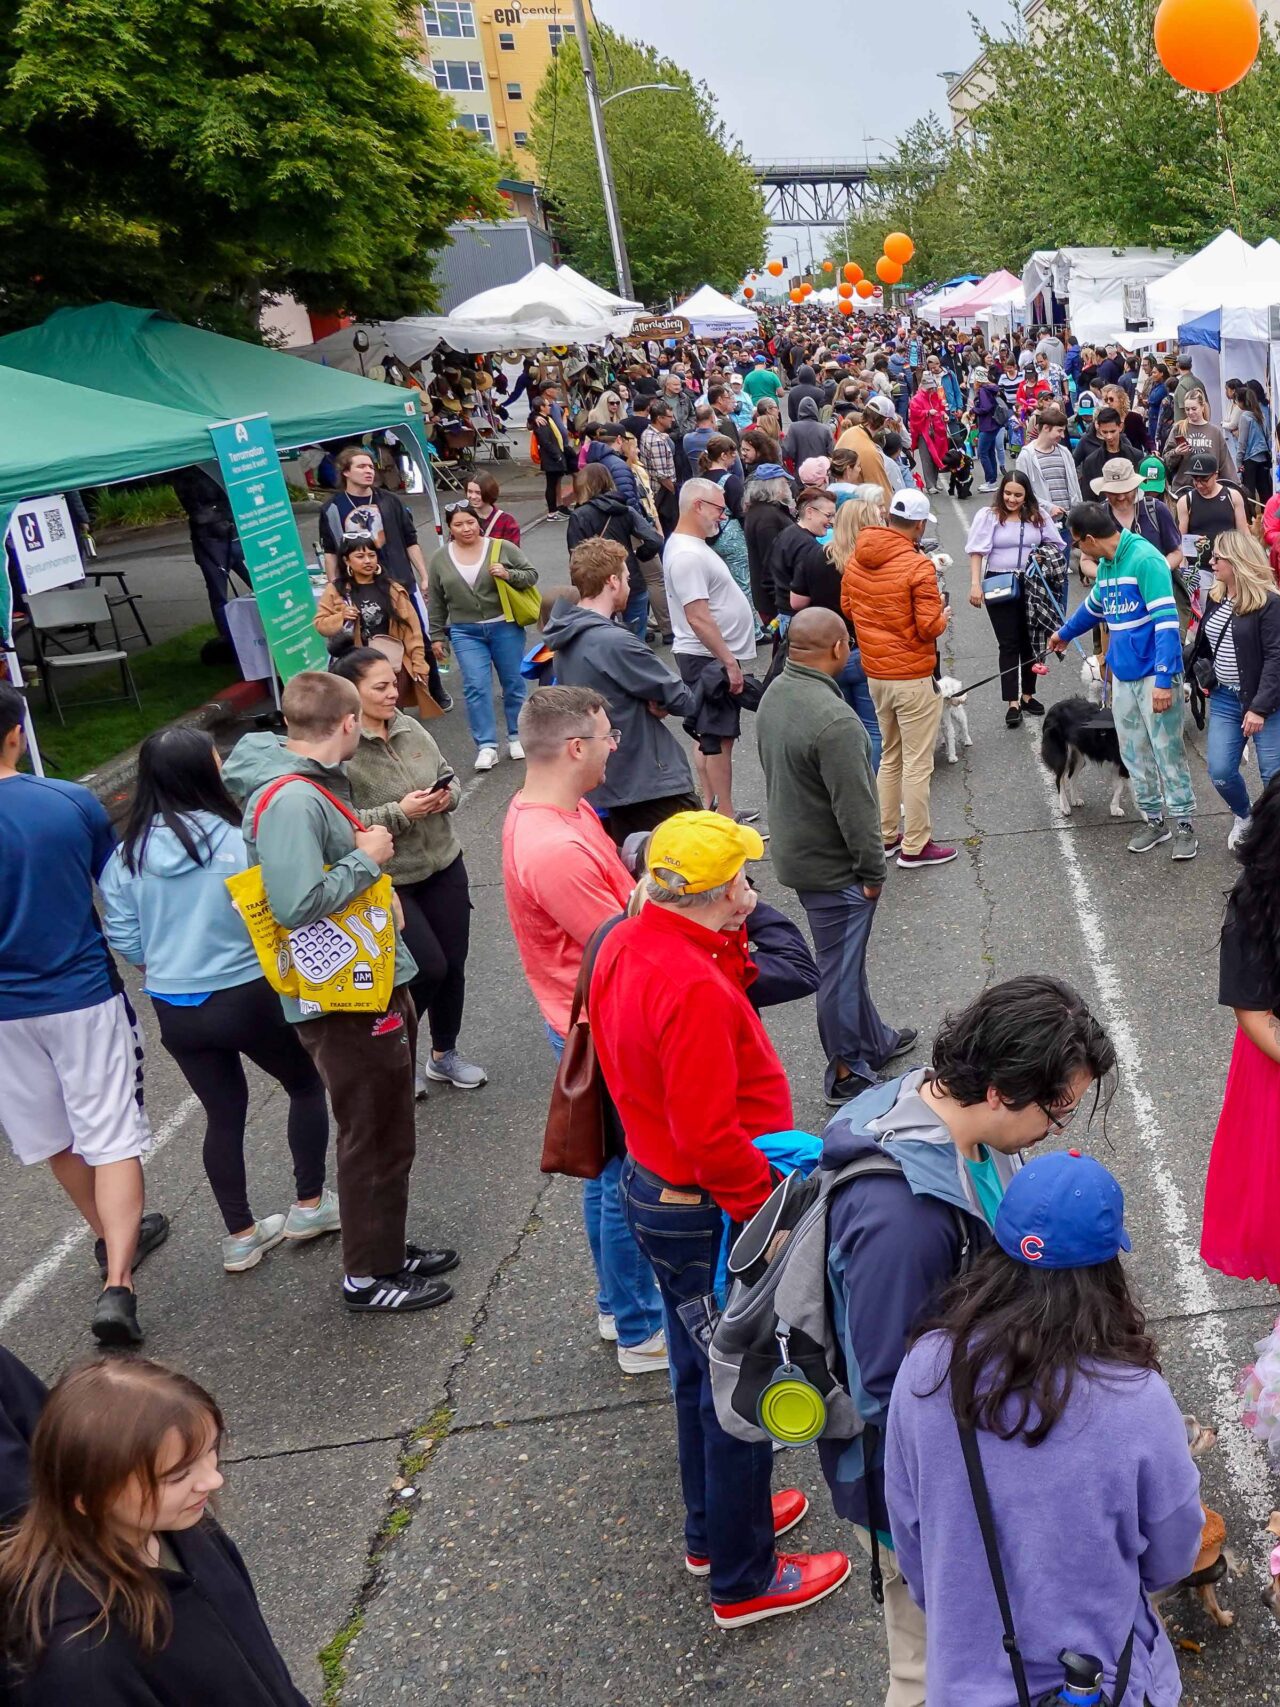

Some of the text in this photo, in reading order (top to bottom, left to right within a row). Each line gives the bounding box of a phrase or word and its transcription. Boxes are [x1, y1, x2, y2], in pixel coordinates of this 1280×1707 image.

[494, 0, 562, 26] epi center
[1193, 439, 1212, 448] FORCE
[665, 855, 680, 866] POLO
[354, 972, 372, 982] JAM
[1020, 1235, 1044, 1261] C
